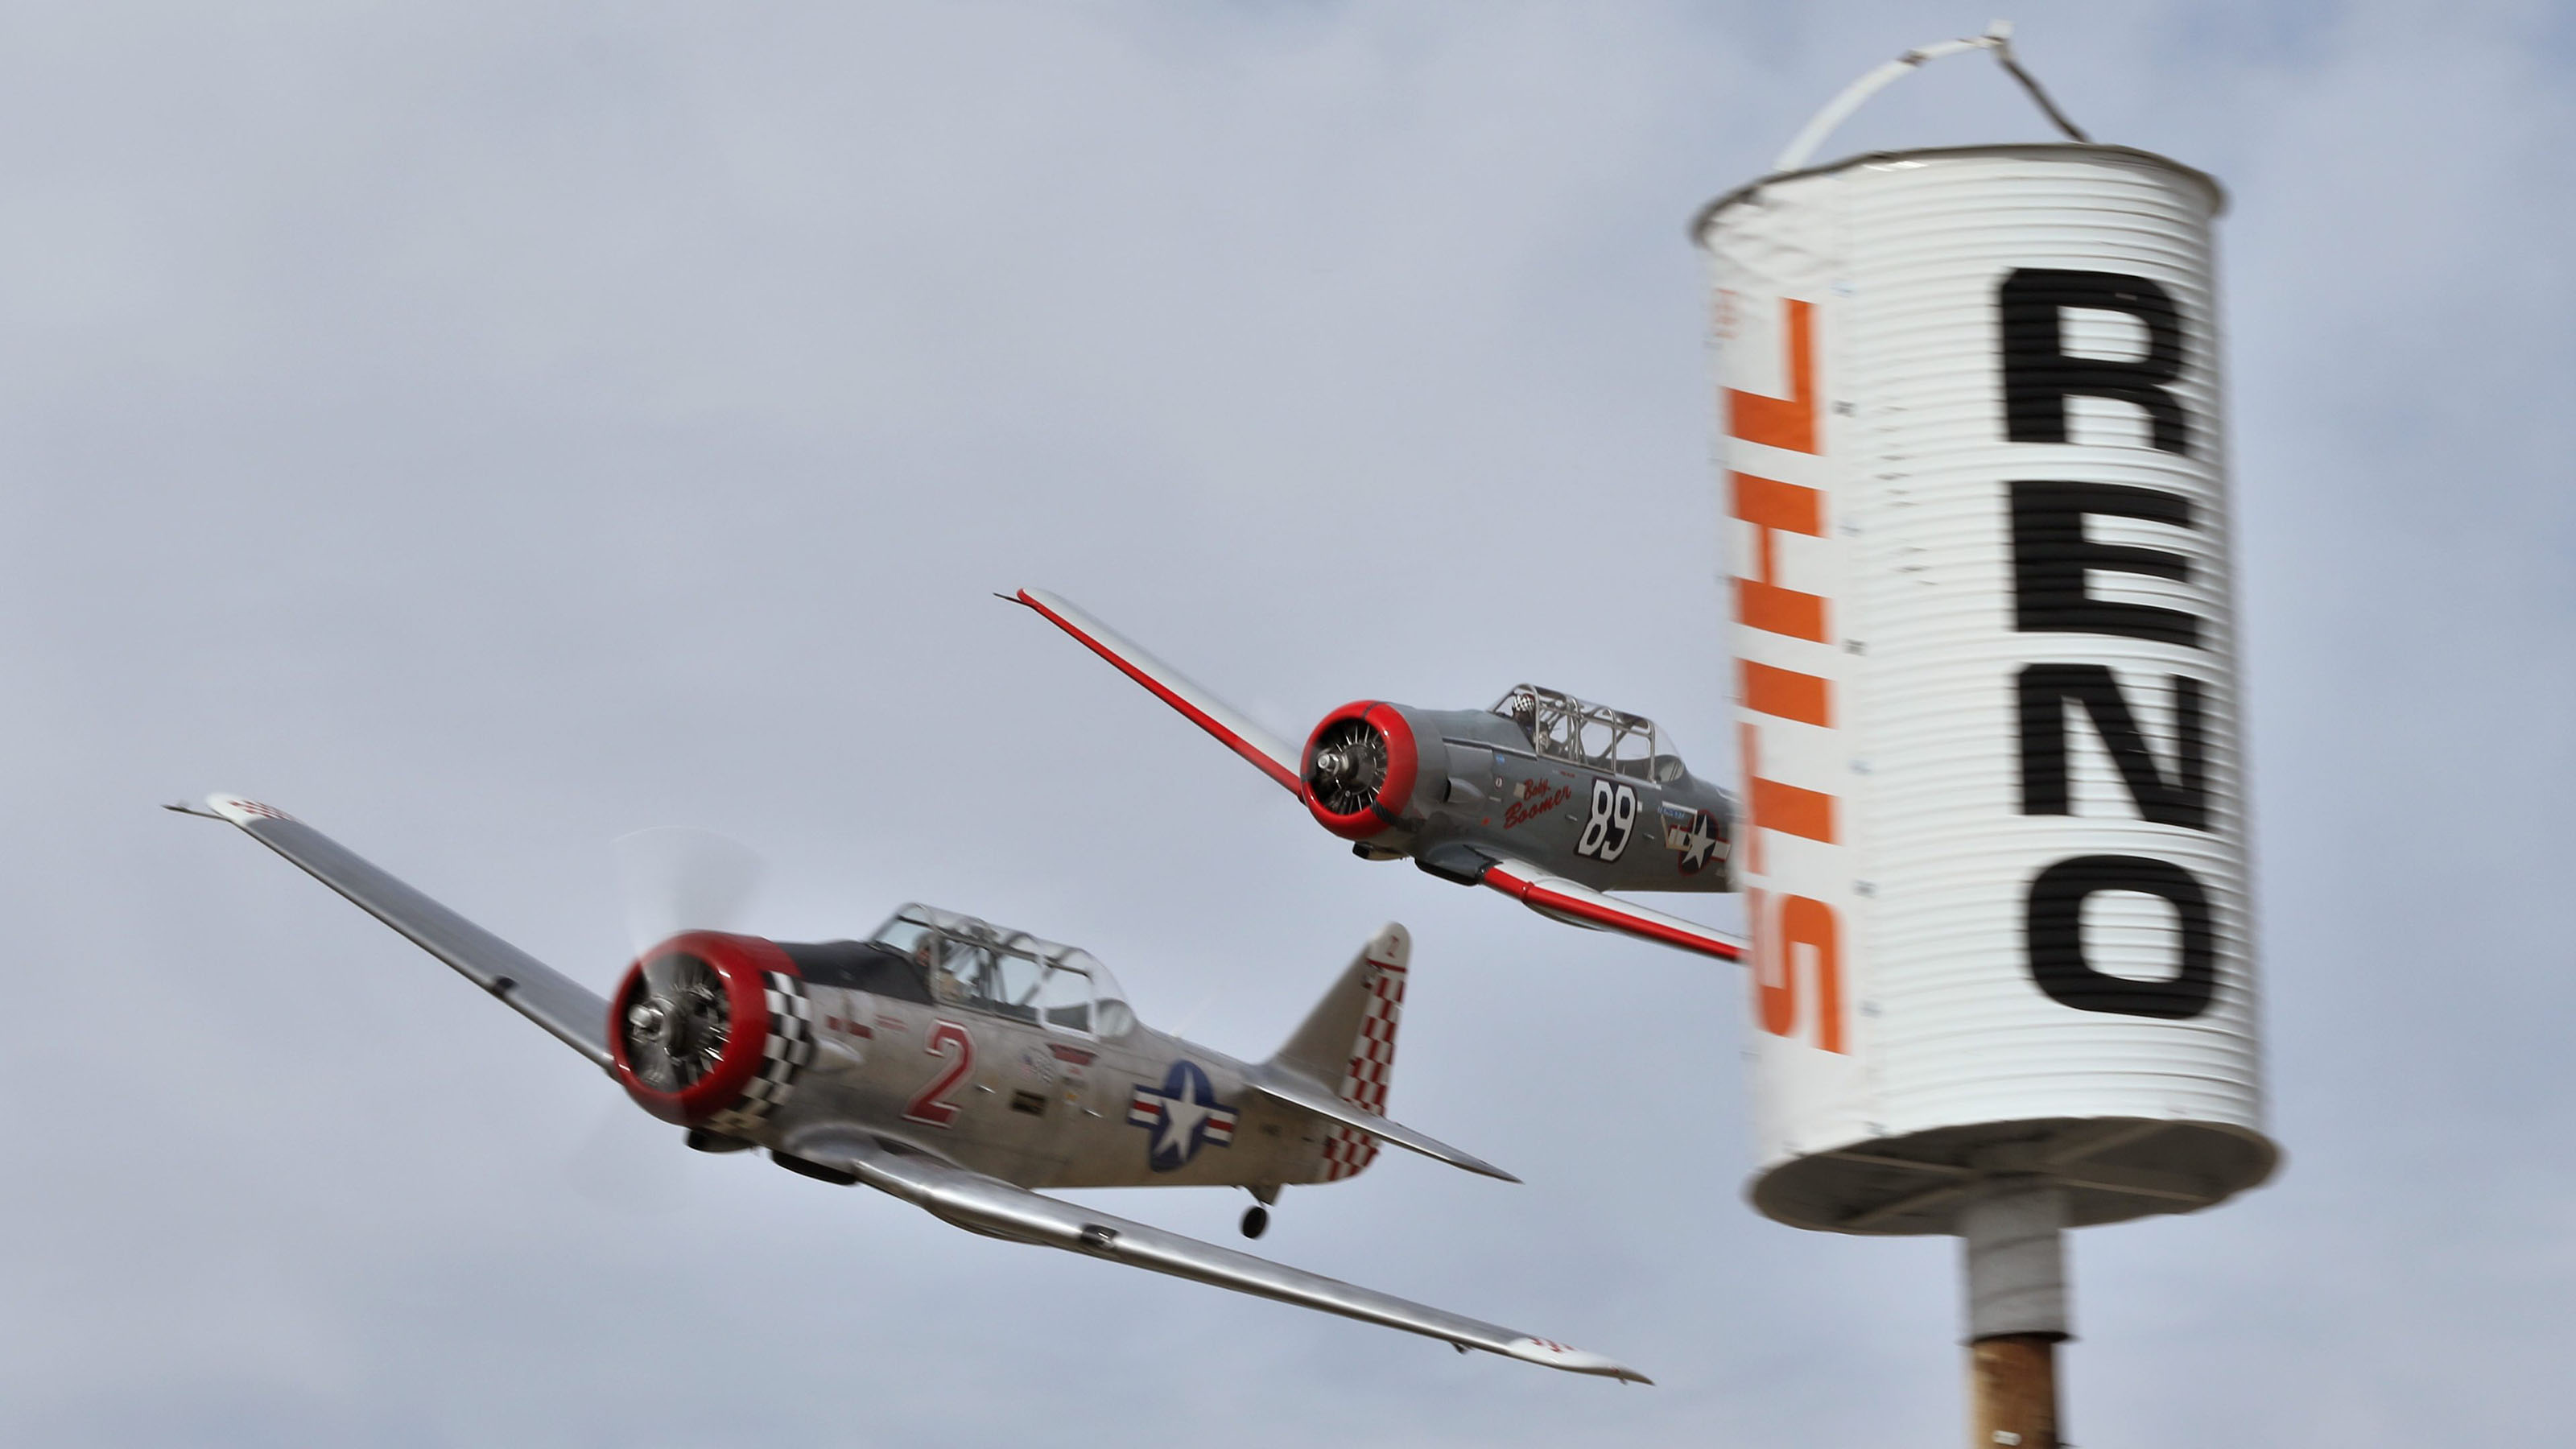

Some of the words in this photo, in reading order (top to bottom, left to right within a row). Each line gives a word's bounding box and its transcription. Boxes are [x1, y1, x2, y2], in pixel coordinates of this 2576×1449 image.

[1719, 295, 1851, 1055] STIHL
[1996, 266, 2215, 1020] RENO
[1503, 784, 1572, 830] Boomer
[1577, 778, 1637, 861] 89
[900, 1017, 976, 1130] 2
